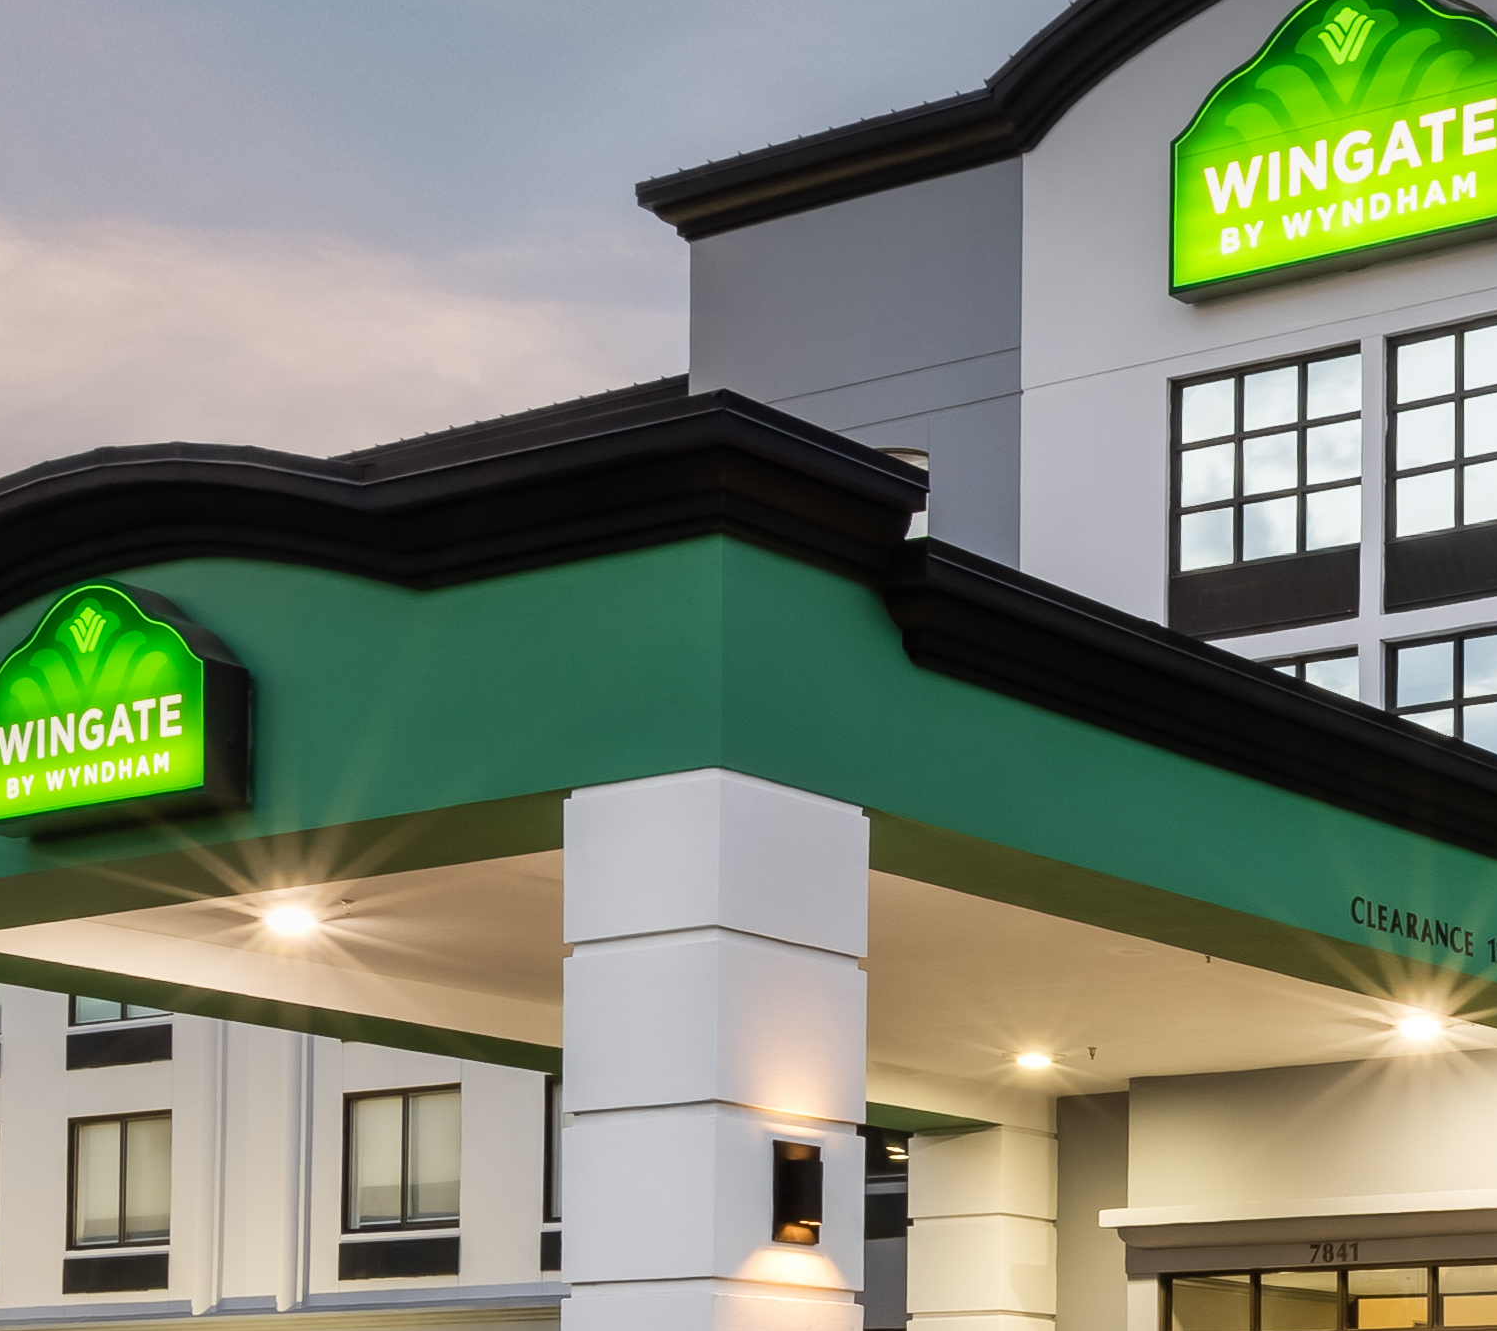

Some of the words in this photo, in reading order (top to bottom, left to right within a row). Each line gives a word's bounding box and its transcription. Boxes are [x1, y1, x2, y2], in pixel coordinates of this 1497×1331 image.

[1204, 97, 1497, 215] WINGATE
[1220, 220, 1265, 255] BY
[1282, 171, 1477, 240] WYNDHAM
[6, 774, 35, 800] BY
[45, 751, 170, 792] WYNDHAM
[1350, 895, 1474, 958] CLEARANCE
[1309, 1242, 1359, 1264] 7841
